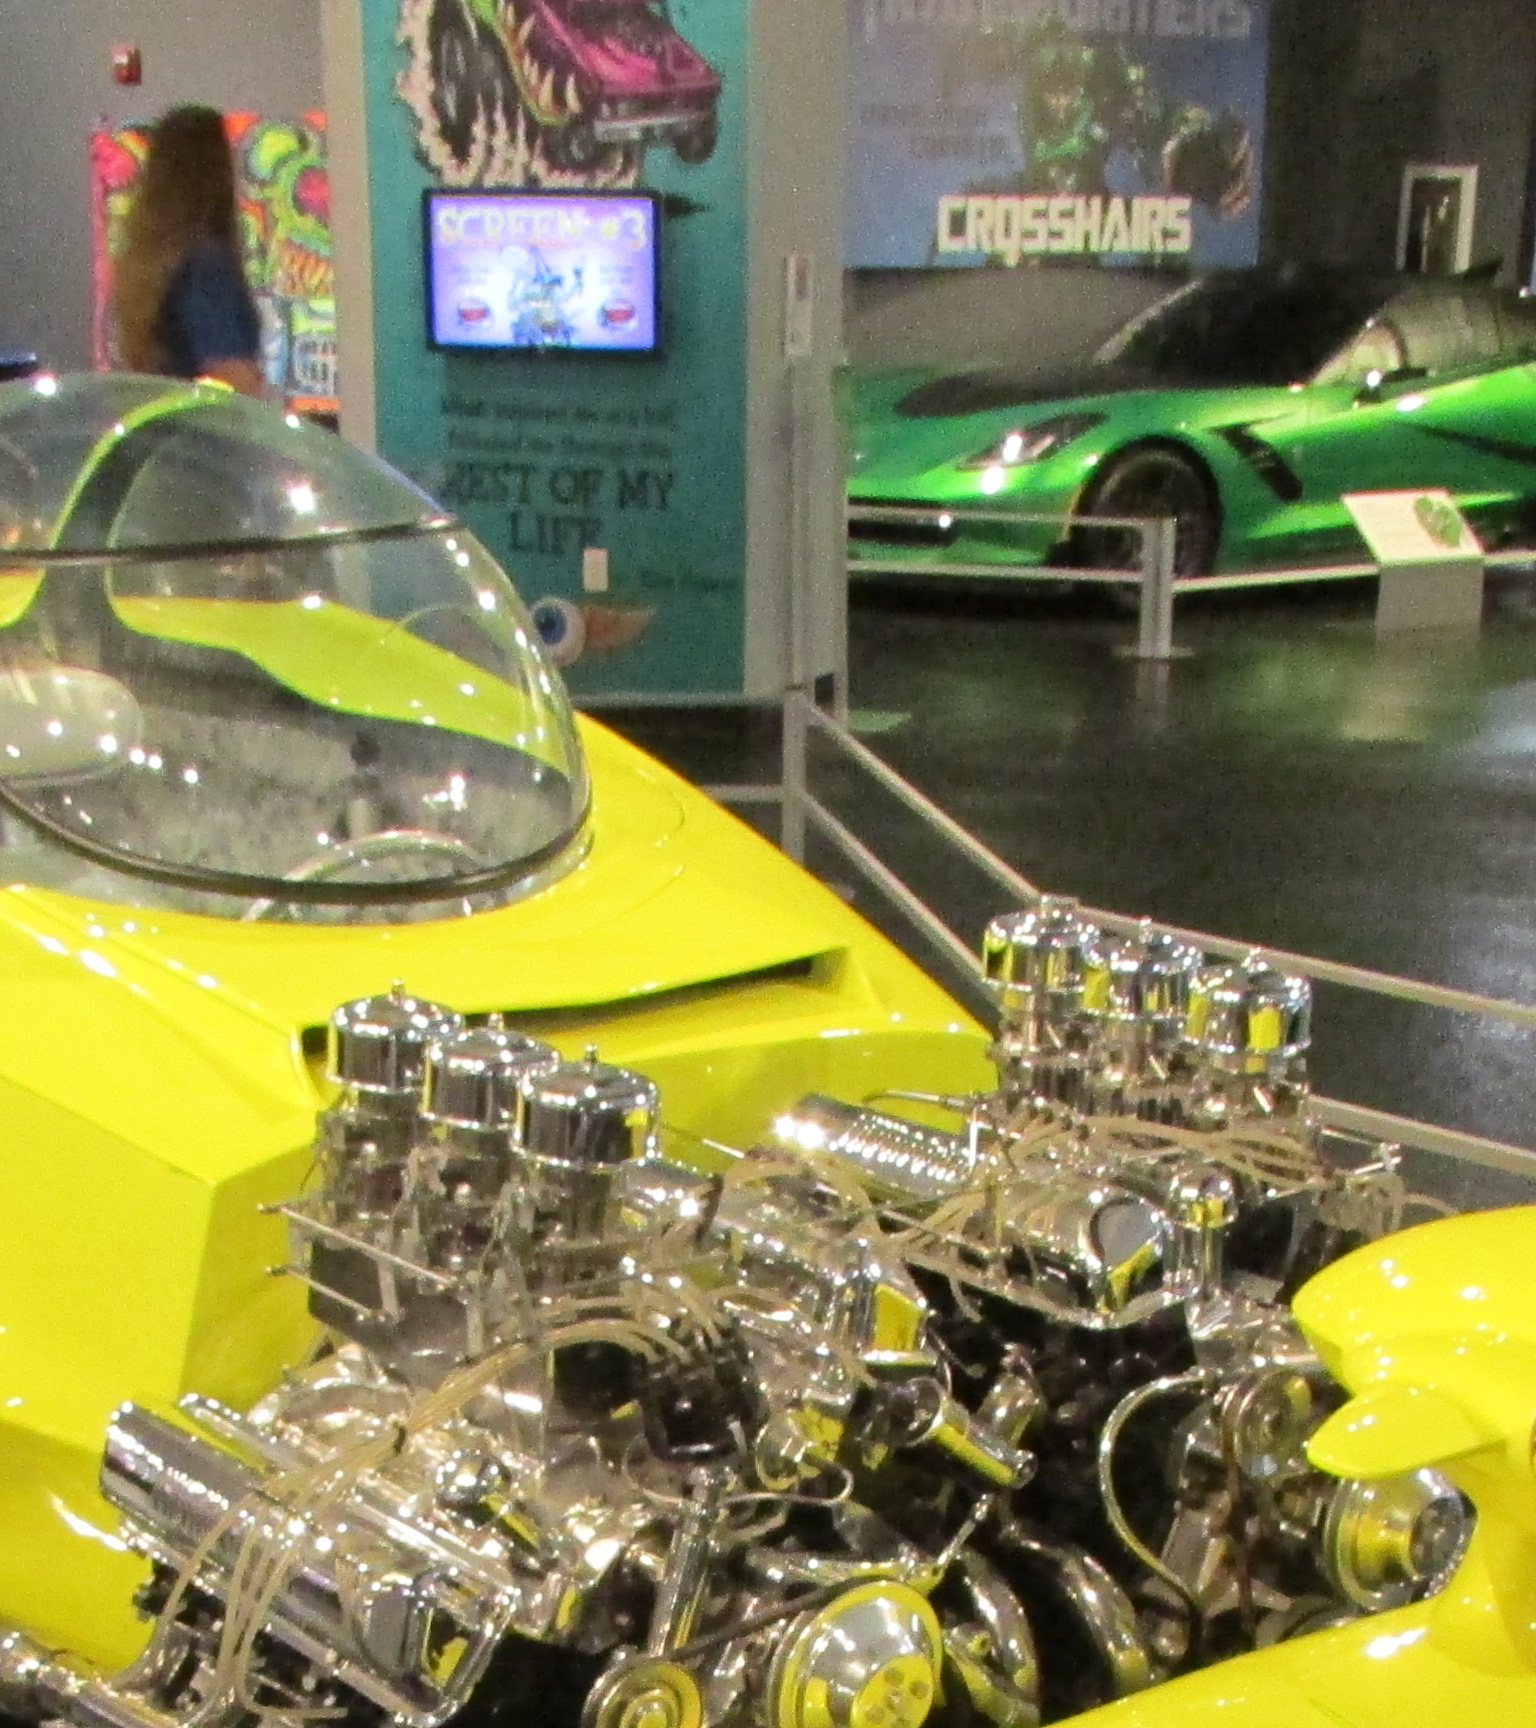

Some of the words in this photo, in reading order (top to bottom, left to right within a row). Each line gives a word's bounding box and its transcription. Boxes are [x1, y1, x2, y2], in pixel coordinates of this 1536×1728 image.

[936, 194, 1194, 266] CROSSHAIRS
[549, 466, 604, 508] OF
[616, 467, 676, 512] MY
